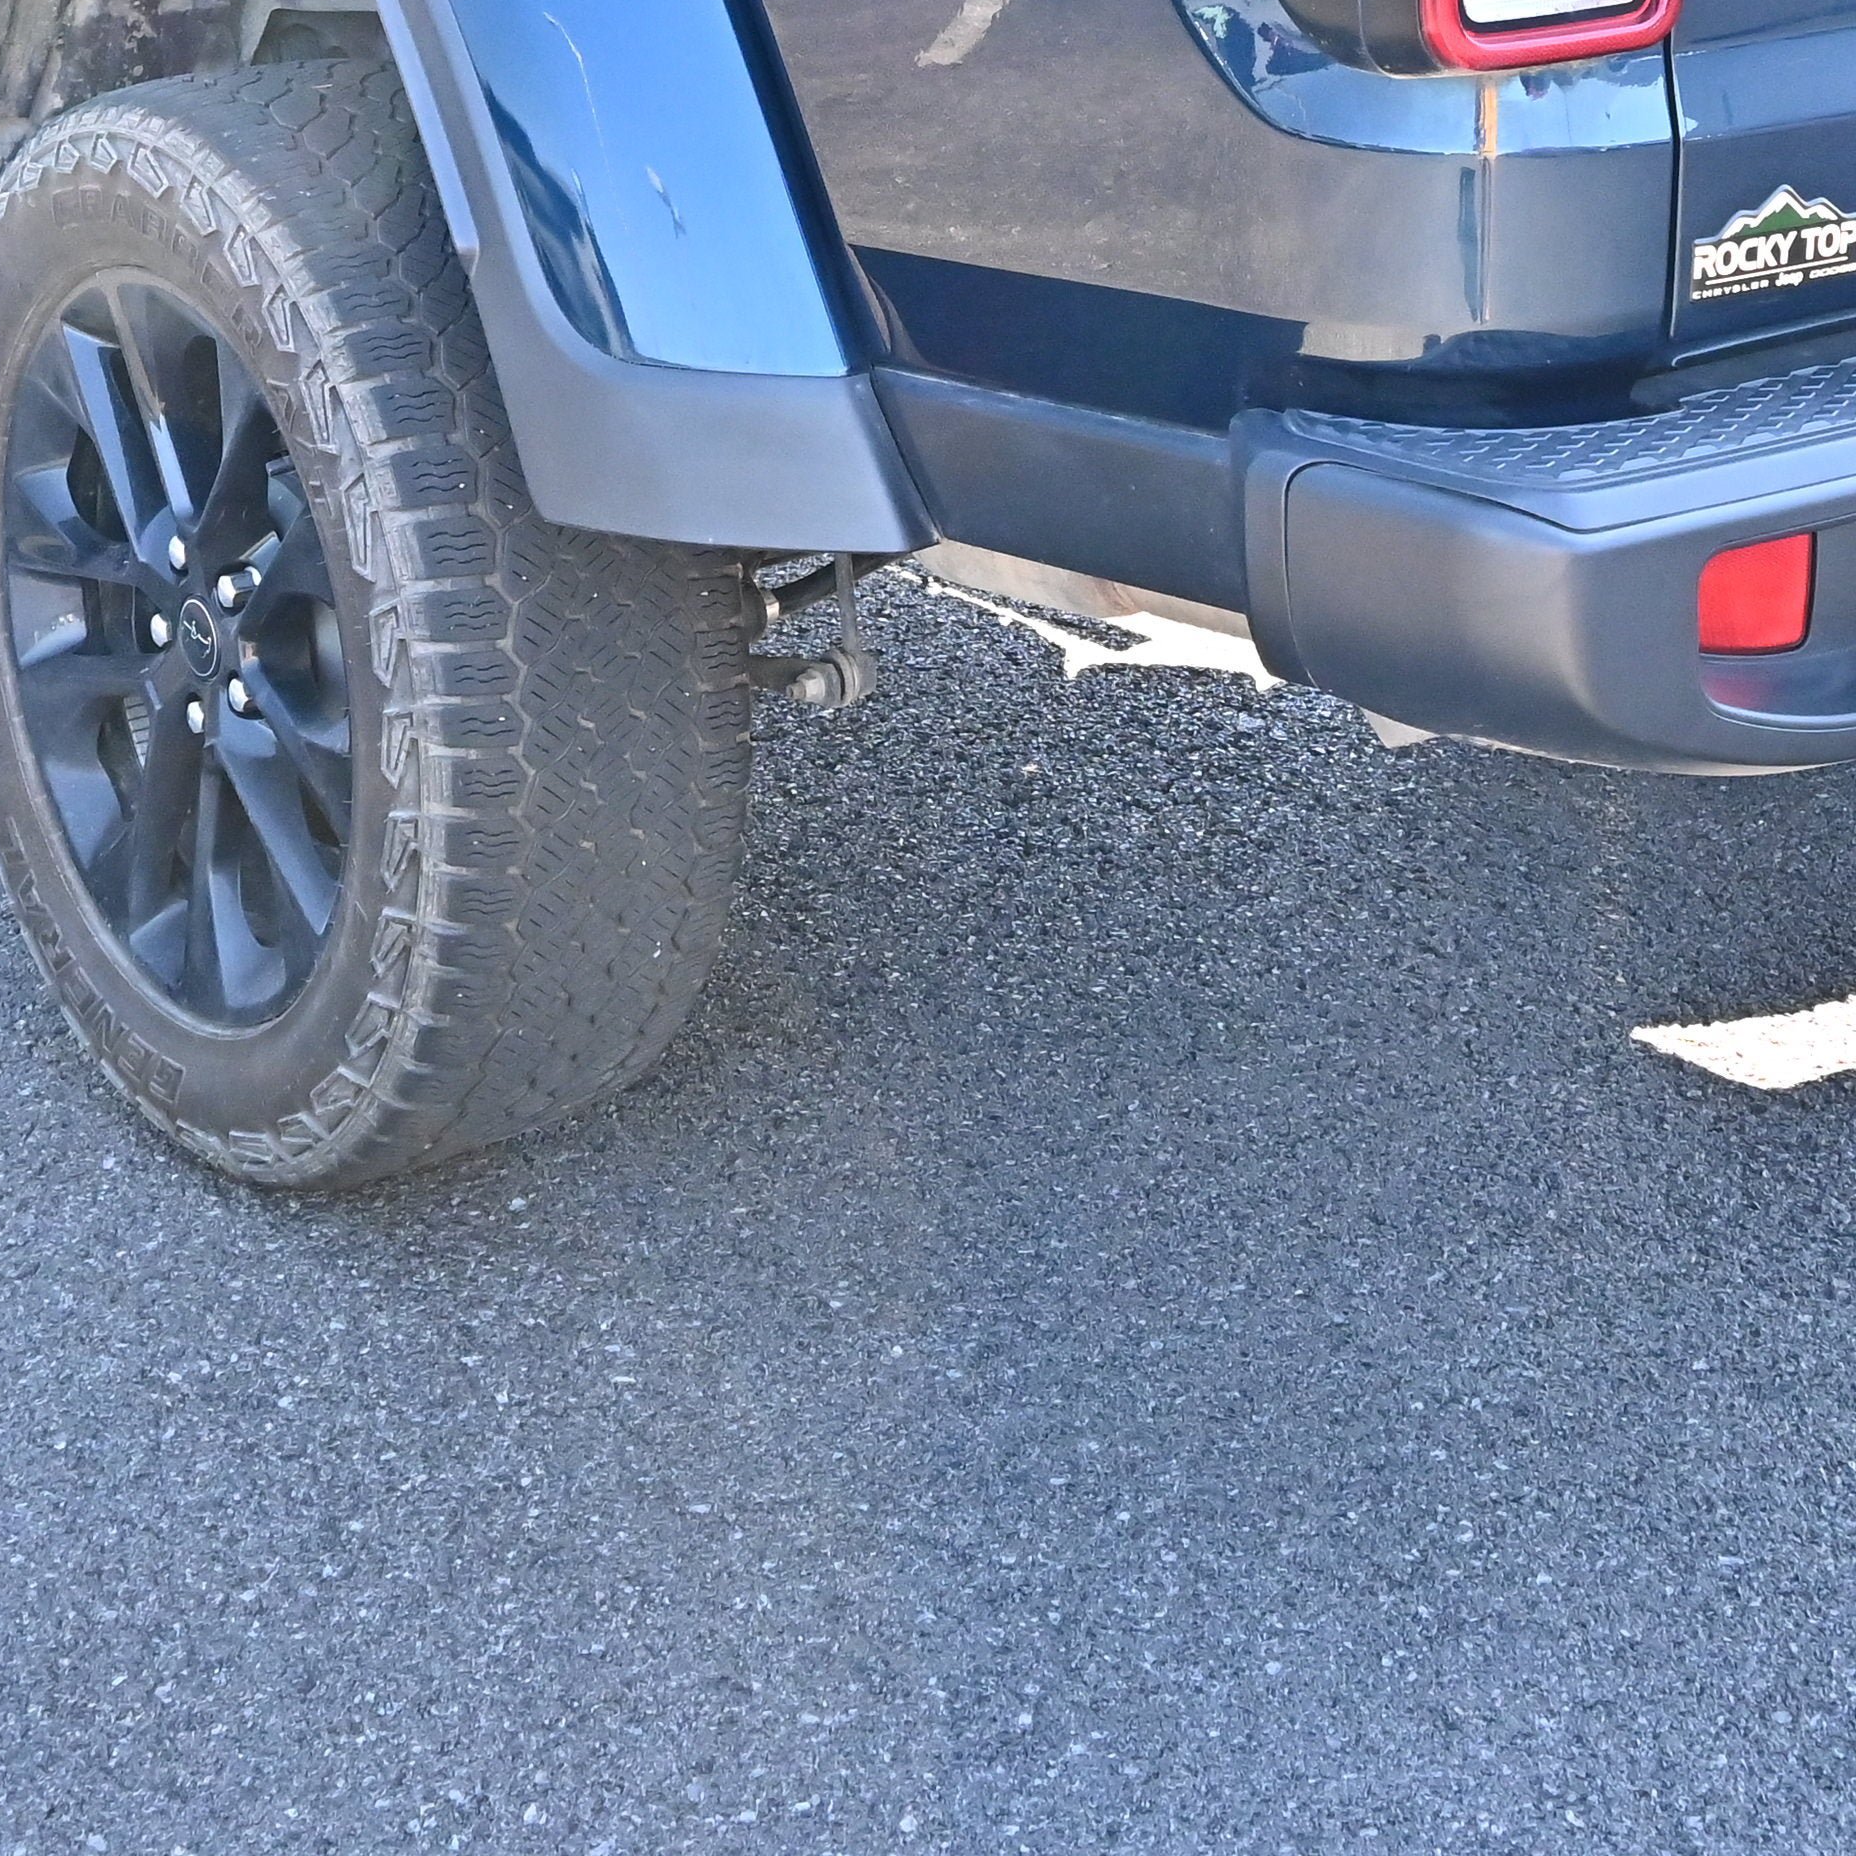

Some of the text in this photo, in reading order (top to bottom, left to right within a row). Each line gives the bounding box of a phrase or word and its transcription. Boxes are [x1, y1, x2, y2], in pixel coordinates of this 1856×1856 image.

[1693, 230, 1798, 281] ROCKY
[1691, 279, 1770, 300] CHRYSLER
[1, 817, 187, 1107] GENERAL
